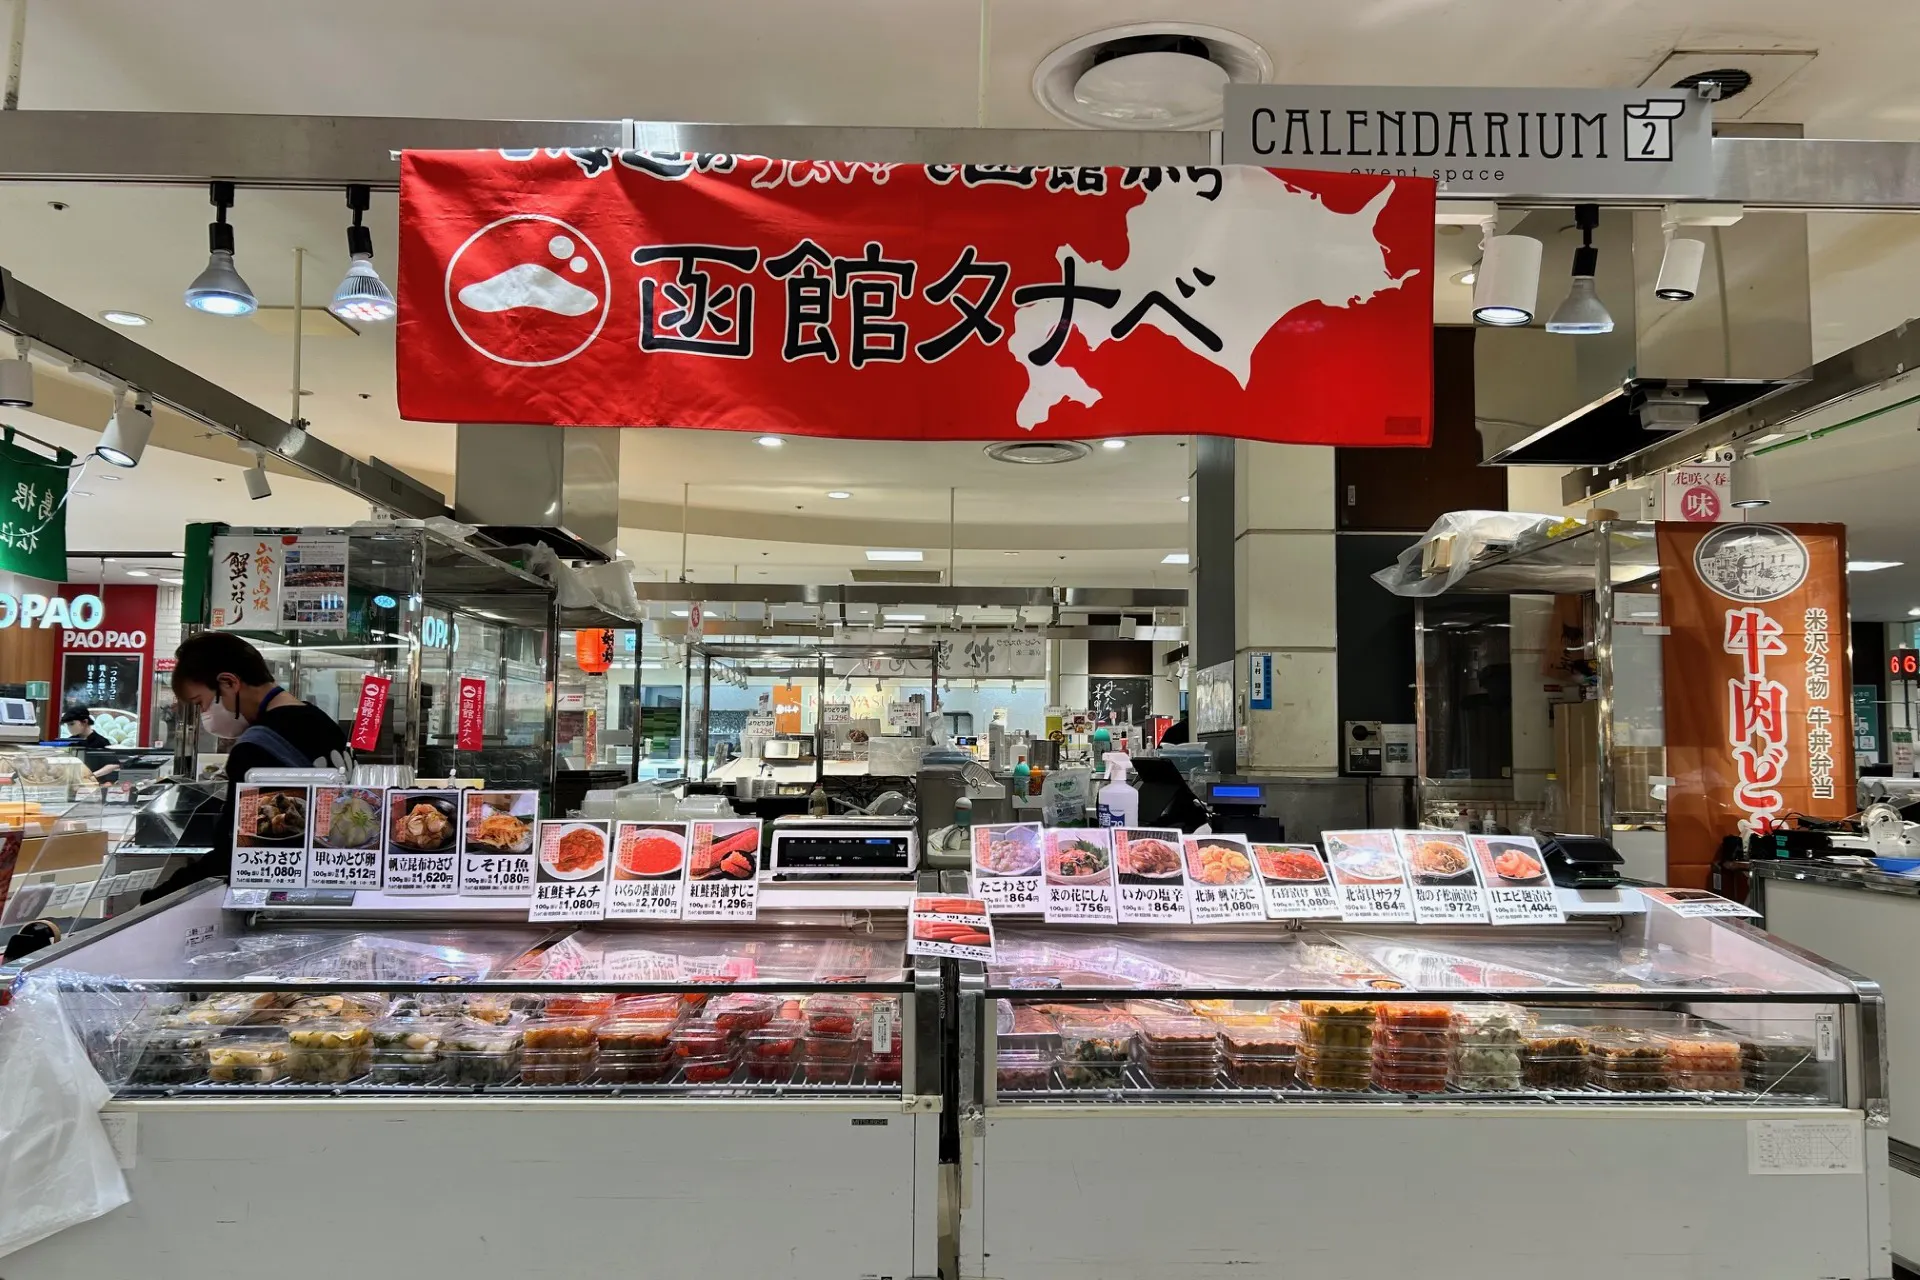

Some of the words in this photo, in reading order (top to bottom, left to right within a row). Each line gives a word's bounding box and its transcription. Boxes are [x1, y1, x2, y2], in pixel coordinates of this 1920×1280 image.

[1252, 107, 1608, 159] CALENDARIUM
[1642, 122, 1657, 156] 2
[1432, 168, 1505, 183] space
[631, 240, 1227, 370] 函館タナベ
[1687, 493, 1715, 518] 味
[221, 552, 250, 625] 蟹いなり
[63, 630, 146, 649] PAOPAO
[1803, 607, 1829, 700] 米沢名物
[1904, 655, 1917, 673] 6
[238, 851, 302, 865] つぶわさび
[315, 851, 376, 866] 甲いかとび卵
[388, 857, 453, 871] 帆立昆布わさび
[265, 866, 301, 878] 1,080円
[465, 858, 529, 873] しそ白魚
[340, 868, 376, 880] 1,512円
[417, 872, 453, 884] 1,620円
[493, 873, 529, 885] 1,080円
[537, 885, 600, 899] 紅鮭キムチ
[690, 883, 754, 897] 紅鮭醤油すじこ
[979, 879, 1038, 893] たこわさび
[1009, 893, 1039, 903] 864円
[1050, 888, 1109, 902] 菜の花にしん
[564, 899, 600, 911] 1,080円
[641, 898, 677, 908] 2,700円
[717, 899, 753, 910] 1,296円
[1081, 902, 1111, 913] 756円
[1154, 902, 1185, 912] 864円
[1223, 901, 1259, 913] 1,080円
[1300, 898, 1336, 908] 1,080円
[1375, 901, 1406, 911] 864円
[1449, 902, 1480, 912] 972円
[1522, 903, 1557, 913] 1,404円
